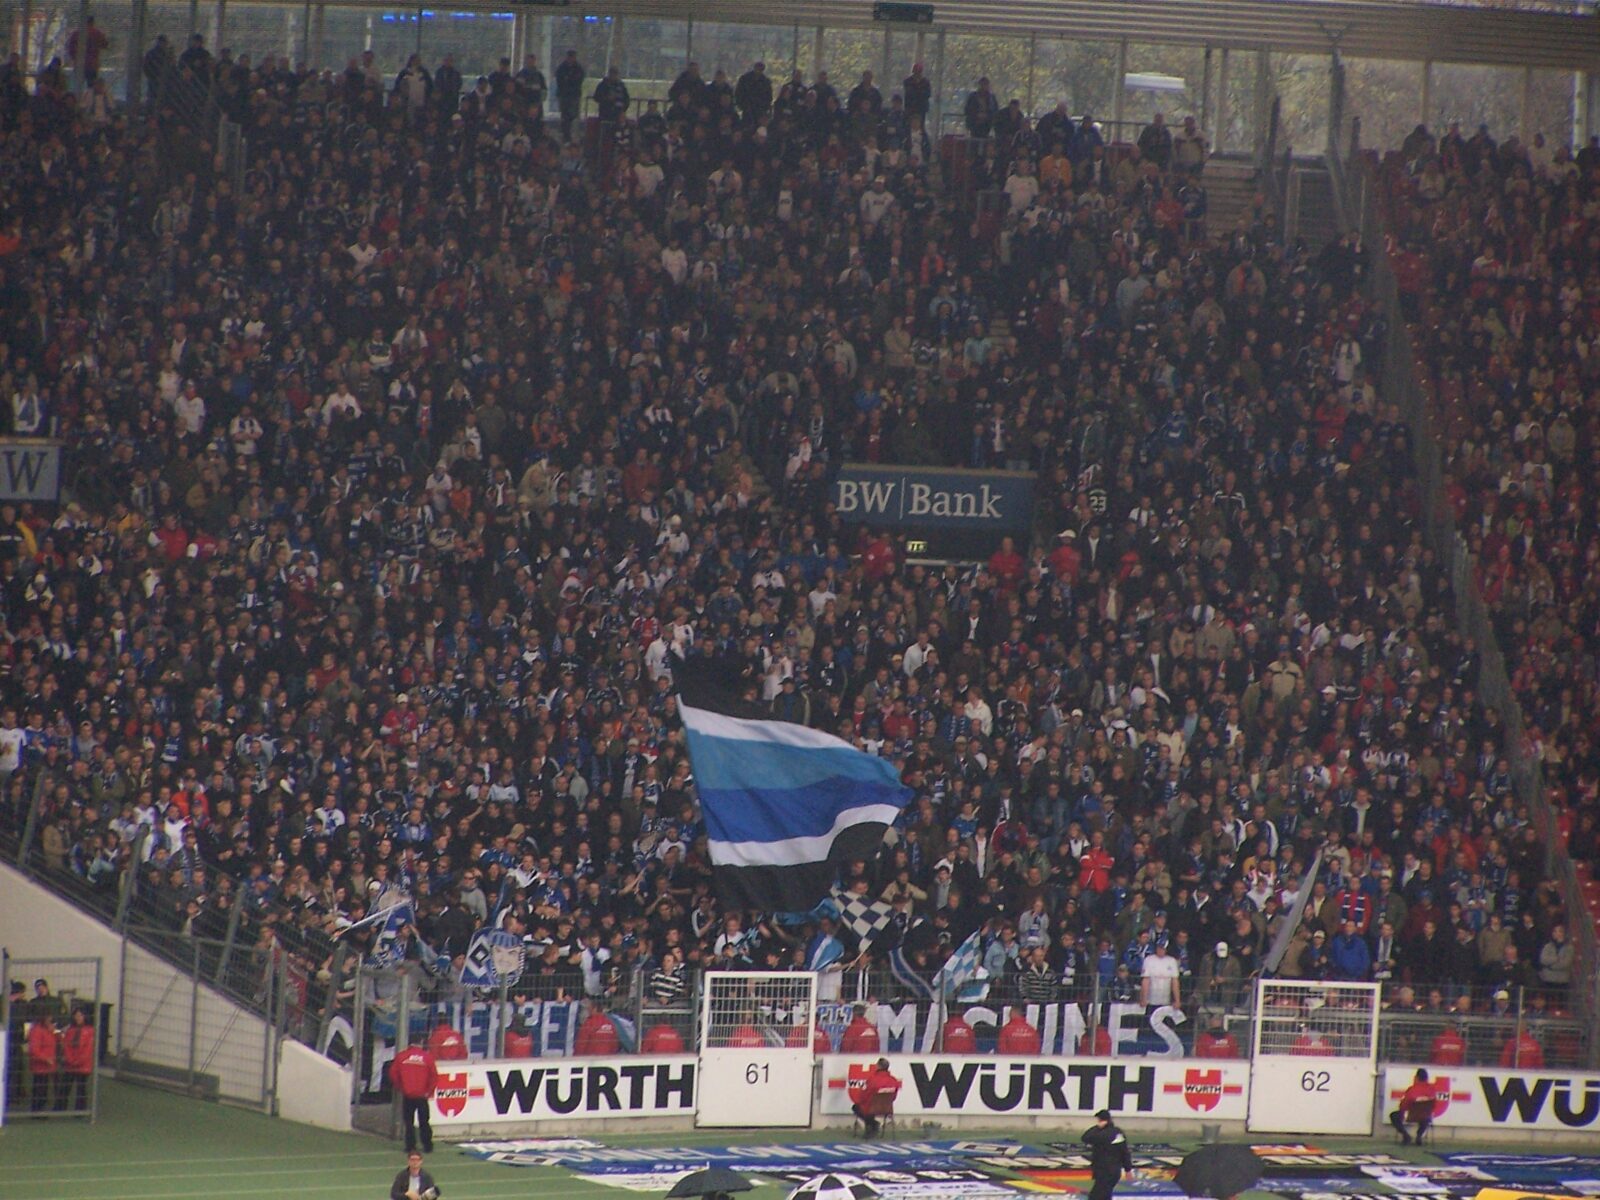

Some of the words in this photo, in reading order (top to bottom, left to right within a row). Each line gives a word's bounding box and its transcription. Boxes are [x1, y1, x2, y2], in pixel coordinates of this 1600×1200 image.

[836, 480, 896, 513] BW
[908, 483, 1003, 518] Bank
[486, 1063, 695, 1115] WÜRTH
[746, 1063, 769, 1085] 61
[909, 1062, 1156, 1112] WÜRTH
[1301, 1070, 1331, 1092] 62
